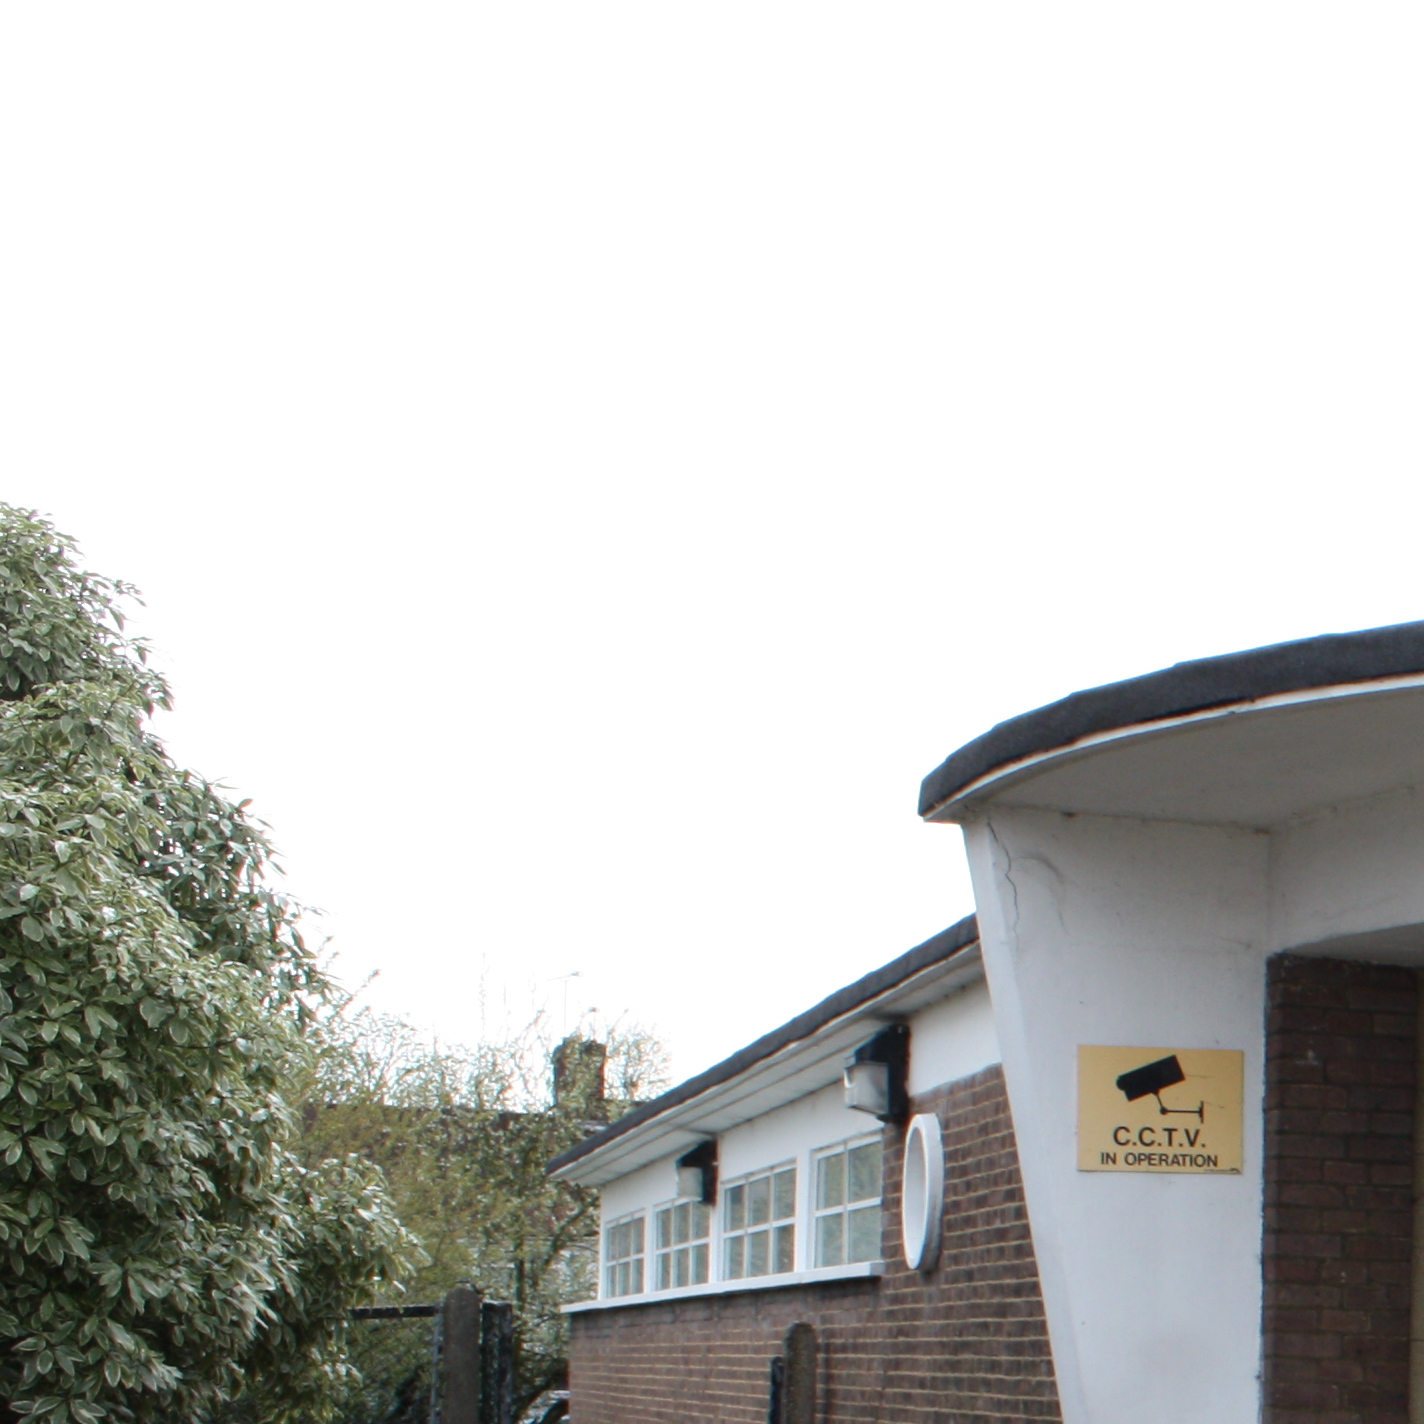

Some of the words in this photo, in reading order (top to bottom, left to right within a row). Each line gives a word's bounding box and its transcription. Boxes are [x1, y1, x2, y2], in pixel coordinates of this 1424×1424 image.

[1113, 1126, 1206, 1149] C.C.T.V.
[1101, 1152, 1117, 1165] IN
[1124, 1152, 1218, 1168] OPERATION
